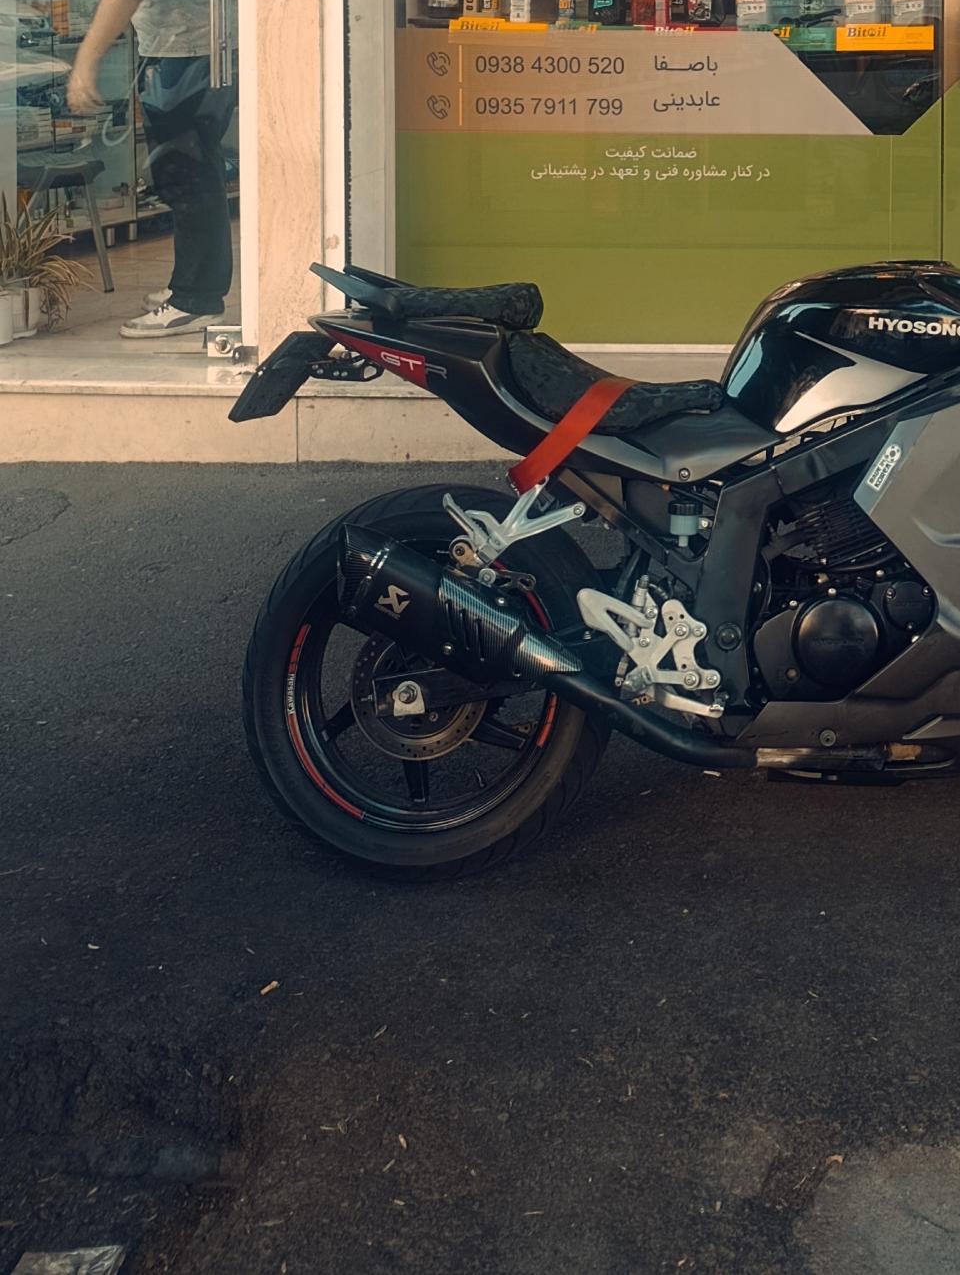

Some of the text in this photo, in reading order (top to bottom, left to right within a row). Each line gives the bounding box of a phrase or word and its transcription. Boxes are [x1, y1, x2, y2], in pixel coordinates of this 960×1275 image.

[475, 56, 625, 74] 0938 4300 520
[475, 97, 623, 116] 0935 7911 799
[653, 91, 721, 113] عابدینی
[605, 145, 697, 162] ضمانت کیفیت
[530, 162, 771, 181] در کنار مشاوره فنی و تعهد در پشتیبانی
[380, 351, 448, 380] GTR
